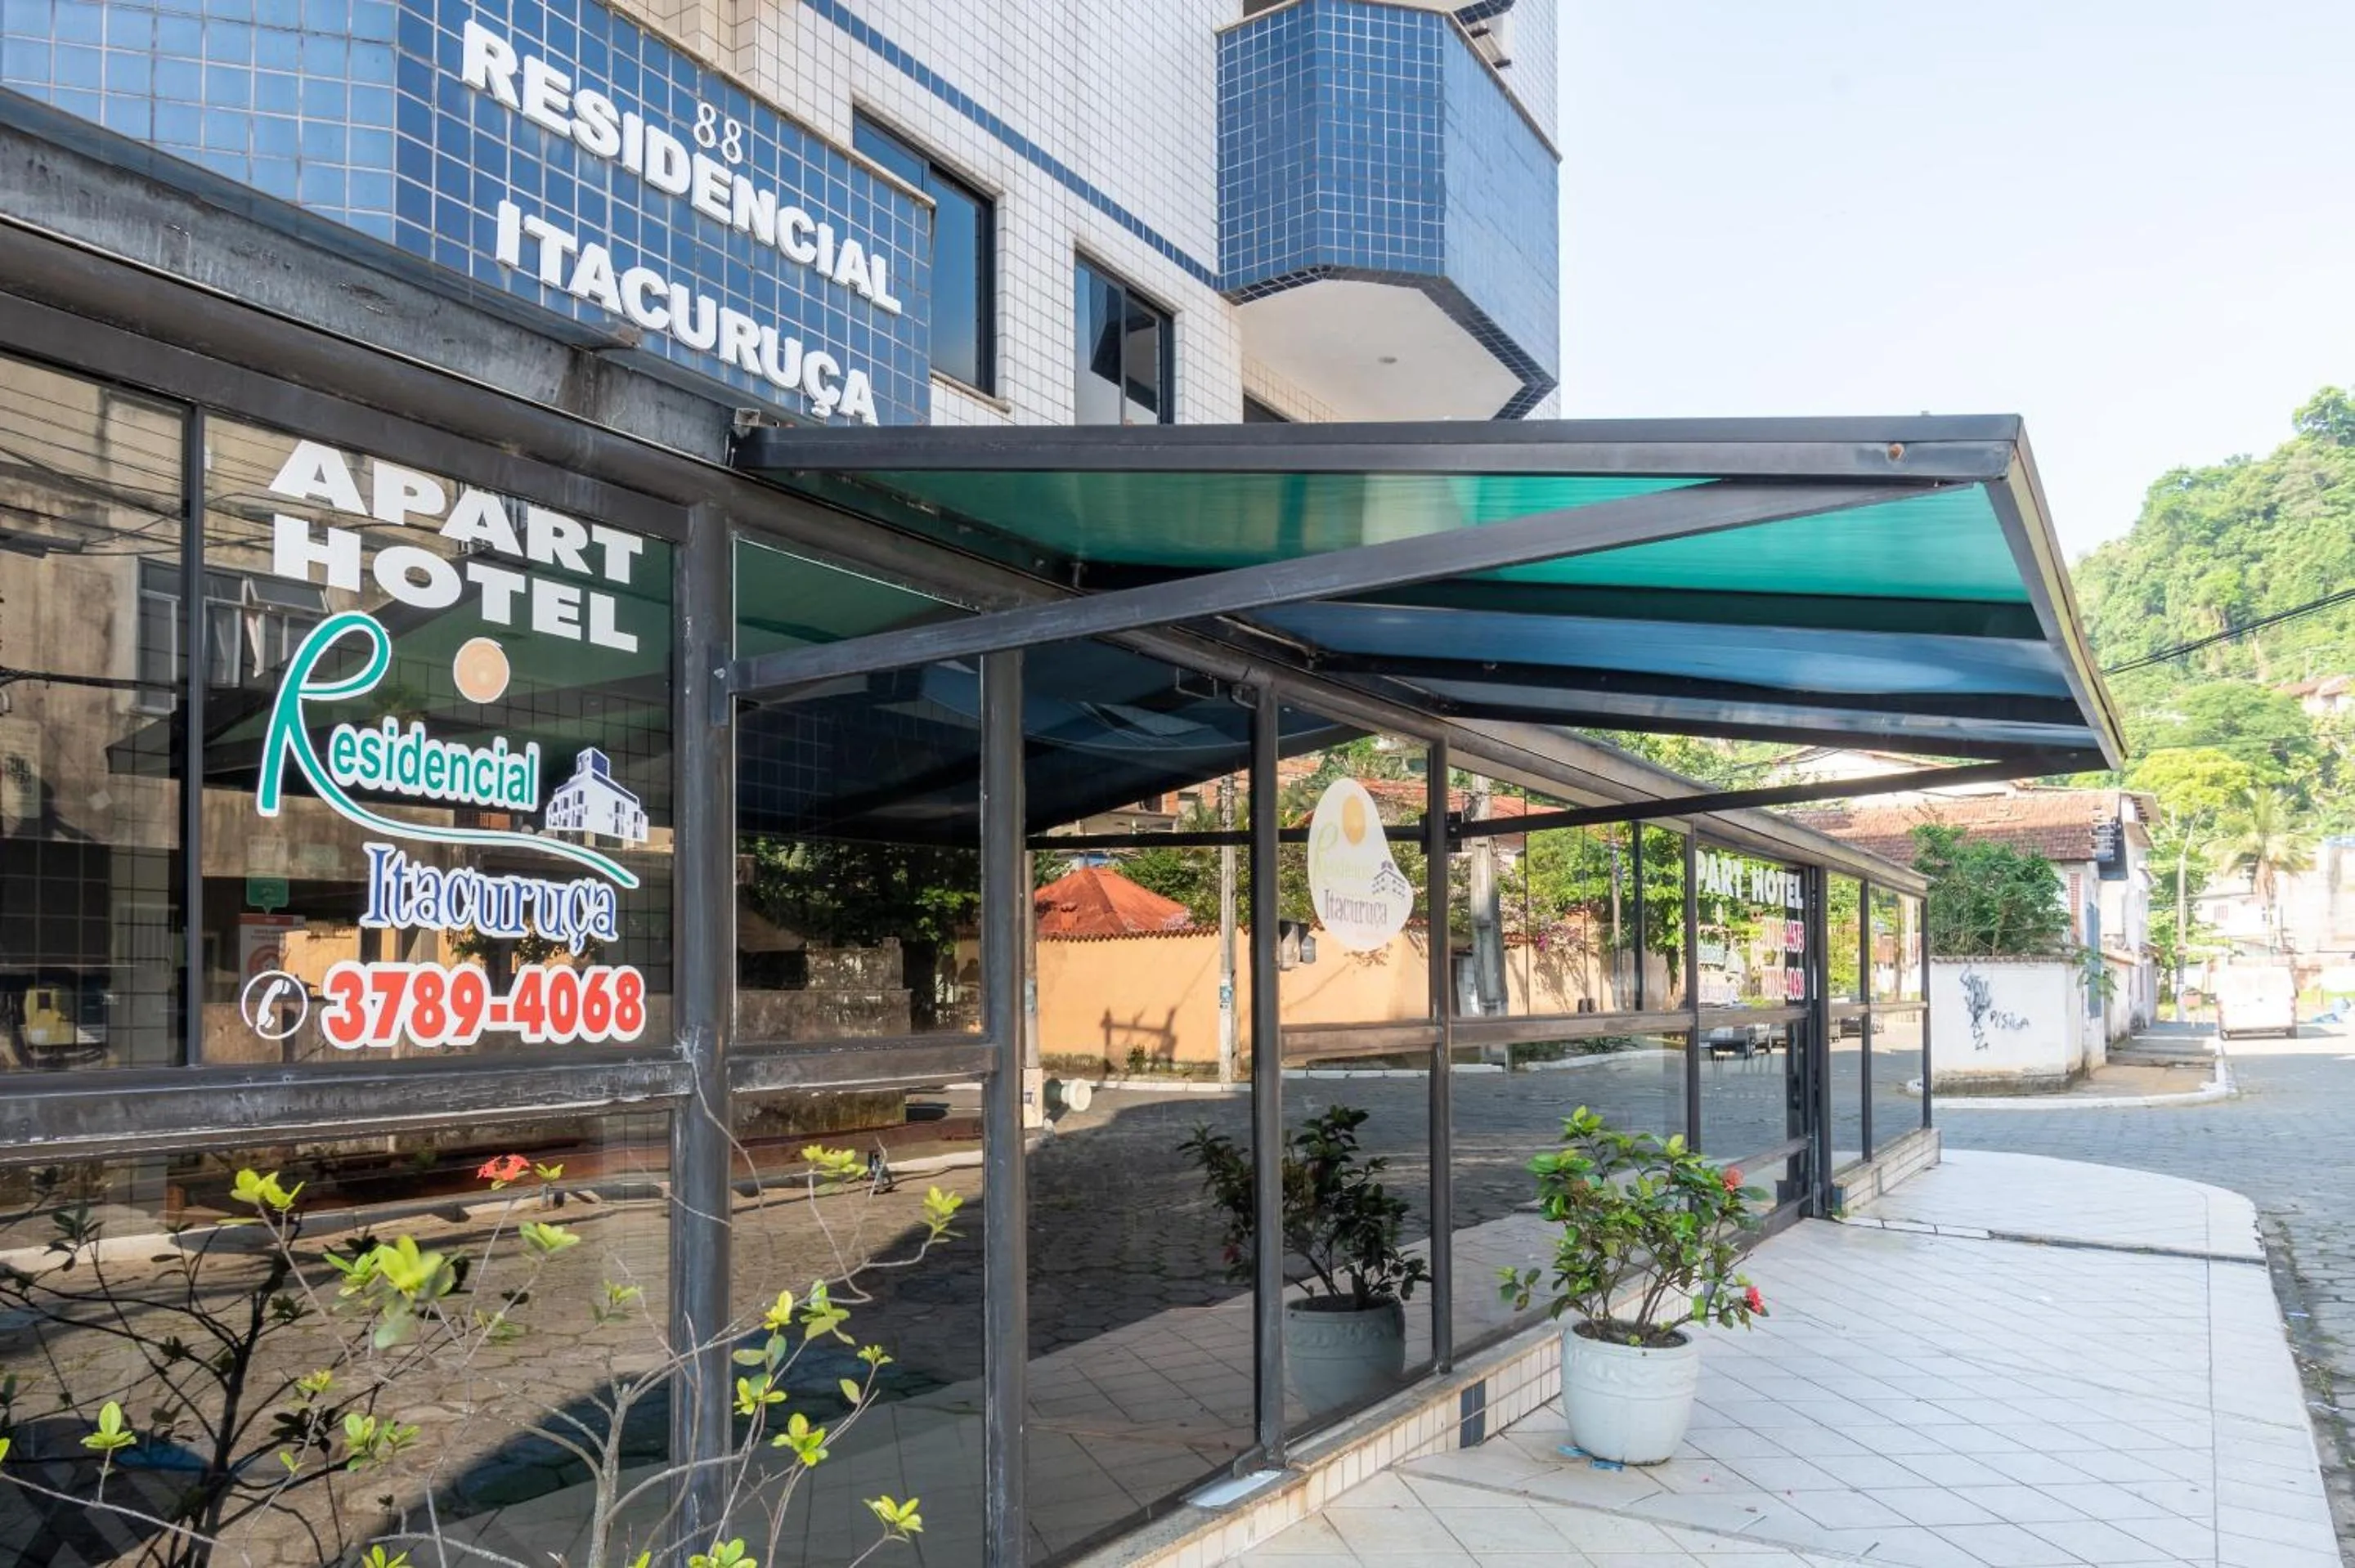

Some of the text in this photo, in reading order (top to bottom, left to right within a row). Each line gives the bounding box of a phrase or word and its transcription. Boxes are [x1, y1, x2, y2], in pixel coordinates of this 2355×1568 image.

[461, 20, 902, 316] RESIDENCIAL
[693, 101, 742, 165] 88
[496, 199, 879, 426] ITACURUÇA
[268, 439, 643, 585] APART
[273, 513, 639, 653] HOTEL
[257, 610, 541, 817] Residencial
[360, 841, 619, 956] Itacuruça
[1695, 849, 1804, 910] PART HOTEL
[321, 961, 646, 1049] 3789-4068
